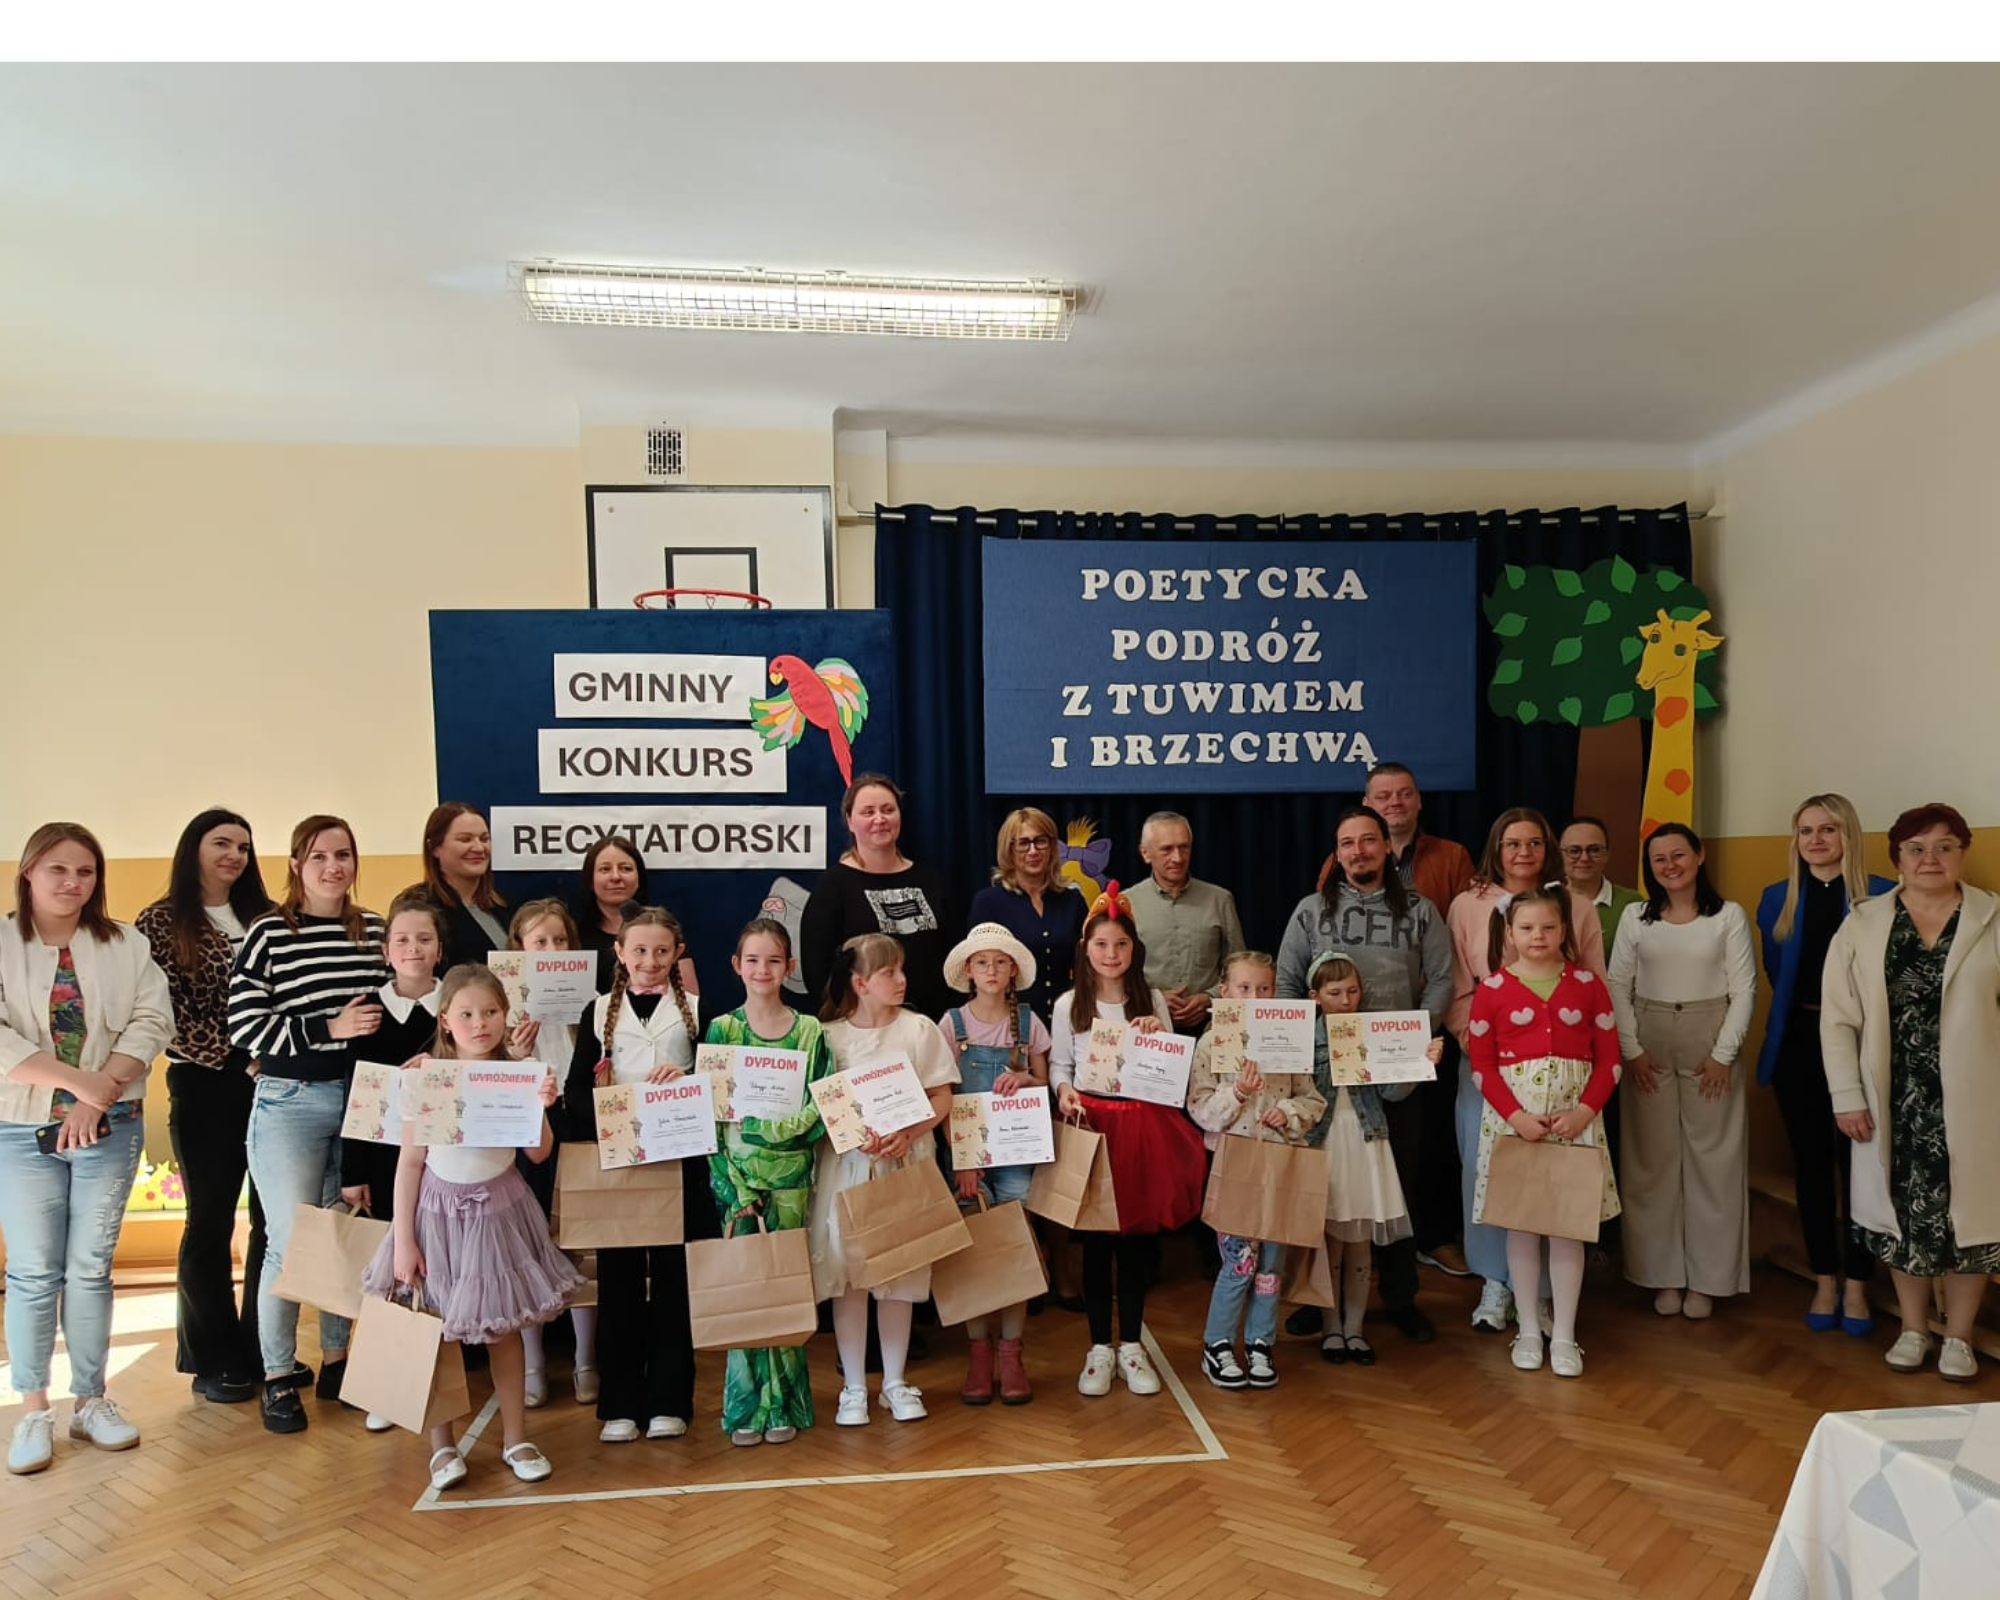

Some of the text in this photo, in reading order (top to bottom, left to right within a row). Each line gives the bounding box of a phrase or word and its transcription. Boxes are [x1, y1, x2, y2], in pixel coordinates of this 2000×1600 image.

[1081, 567, 1369, 601] POETYCKA
[1111, 617, 1322, 664] PODRÓŻ
[568, 672, 733, 704] GMINNY
[1062, 680, 1365, 716] Z TUWIMEM
[558, 747, 753, 777] KONKURS
[1050, 731, 1379, 772] I BRZECHWĄ
[513, 824, 812, 855] RECYTATORSKI
[536, 960, 588, 972] DYPLOM
[1255, 1008, 1306, 1020] DYPLOM
[1371, 1020, 1421, 1032] DYPLOM
[1134, 1036, 1185, 1055] DYPLOM
[744, 1056, 798, 1071] DYPLOM
[645, 1085, 702, 1104] DYPLOM
[992, 1097, 1041, 1112] DYPLOM
